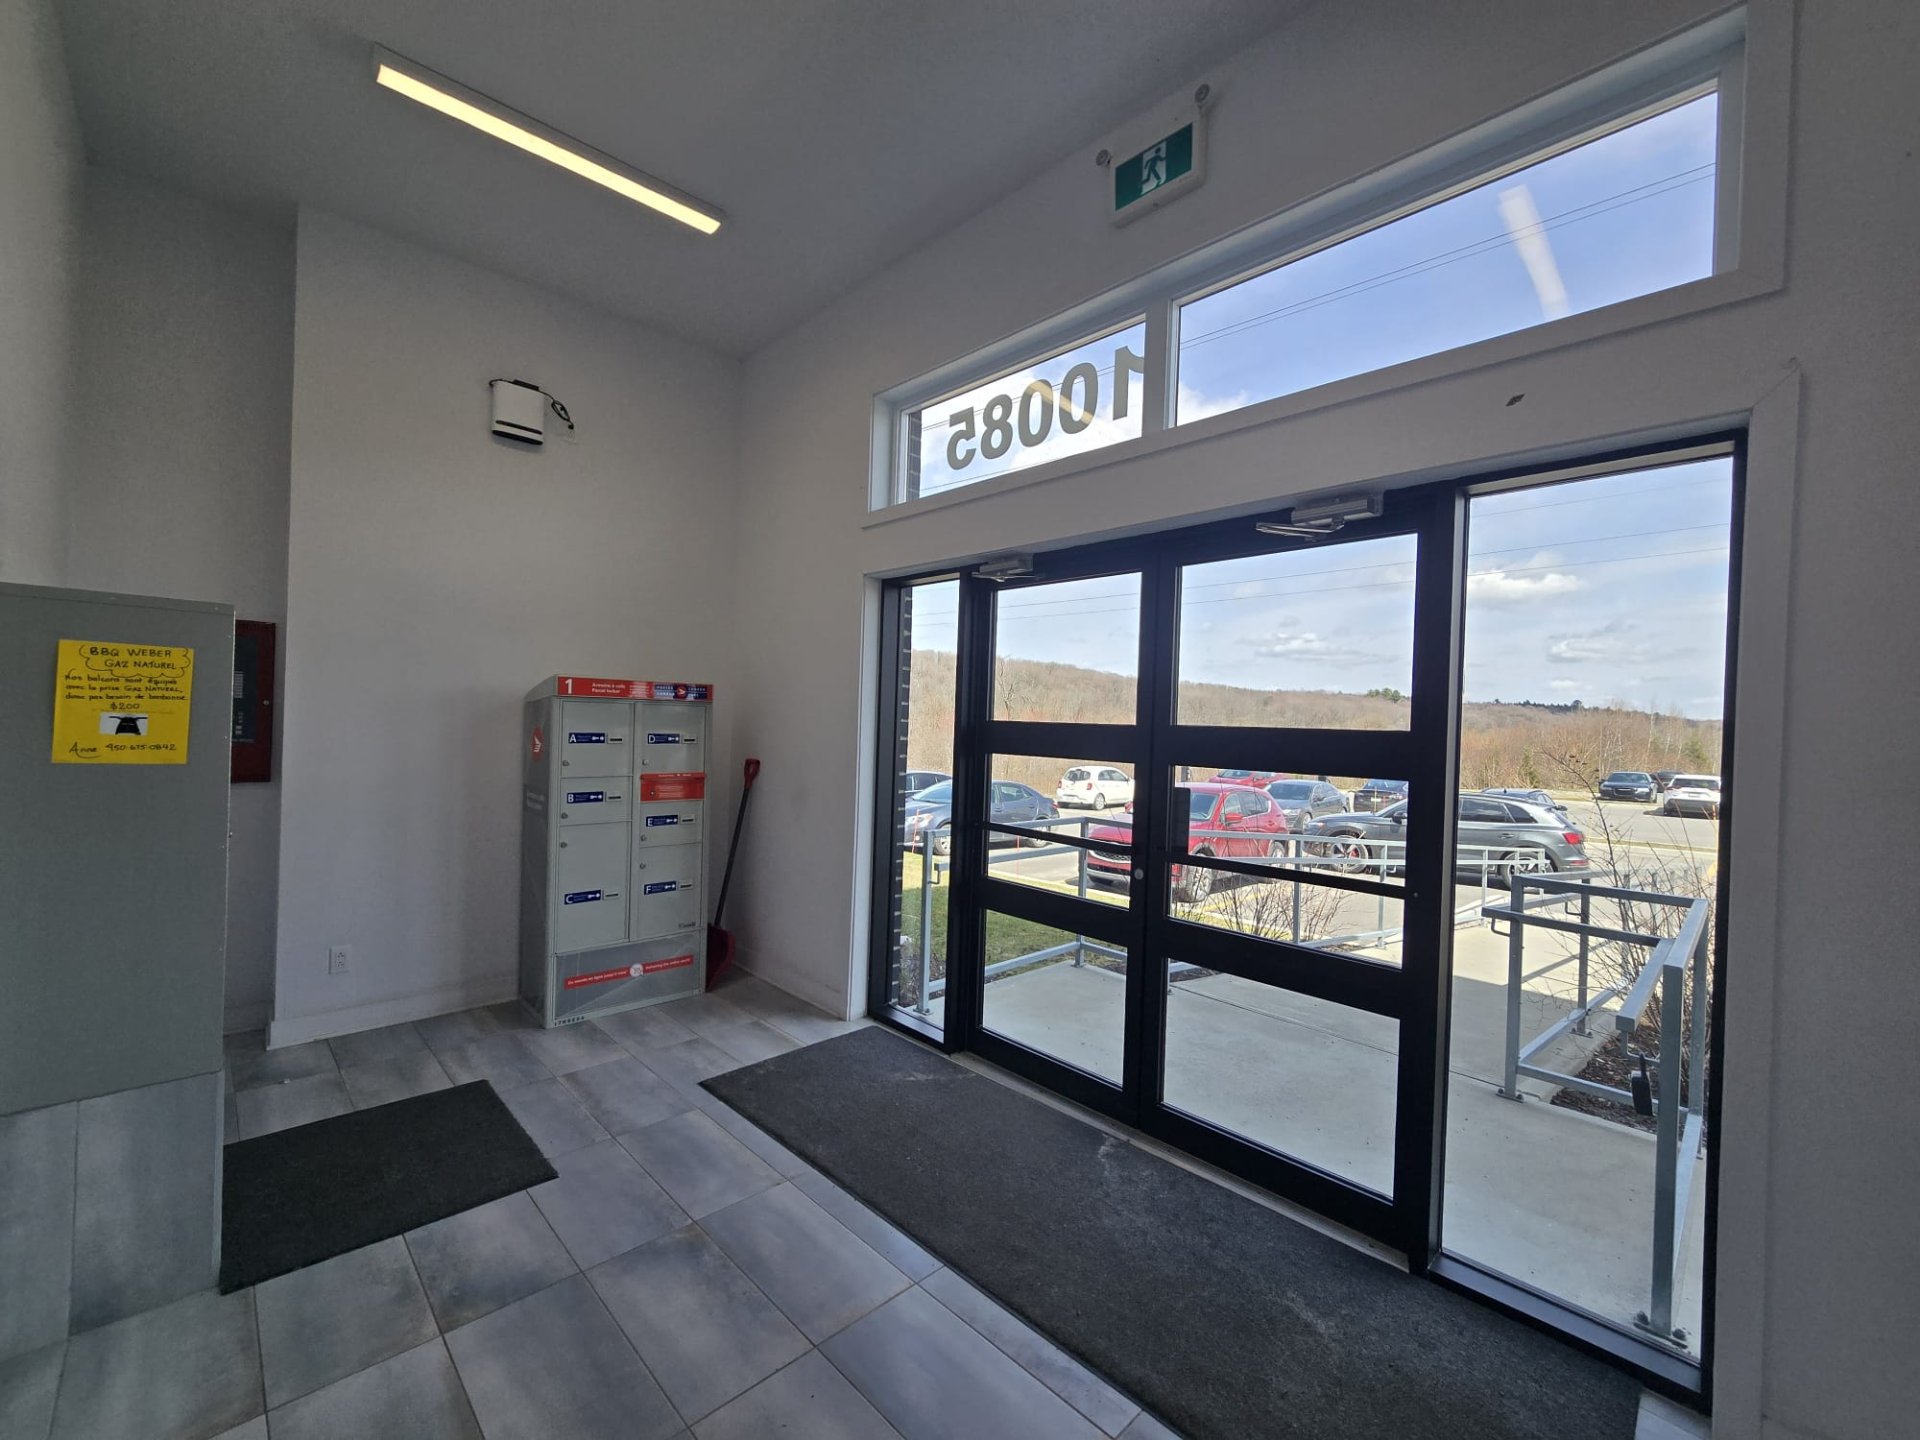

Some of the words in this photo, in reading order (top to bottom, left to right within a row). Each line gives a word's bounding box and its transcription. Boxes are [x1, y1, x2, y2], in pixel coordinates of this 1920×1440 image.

[89, 646, 120, 657] BBQ
[127, 648, 172, 657] WEBER
[104, 659, 129, 668] GAZ
[133, 661, 177, 670] NATUREL
[565, 678, 573, 694] 1
[110, 701, 140, 711] $200
[569, 734, 577, 743] A
[648, 734, 656, 743] D
[567, 794, 575, 803] B
[647, 818, 654, 827] E
[645, 885, 652, 894] F
[565, 894, 574, 904] C
